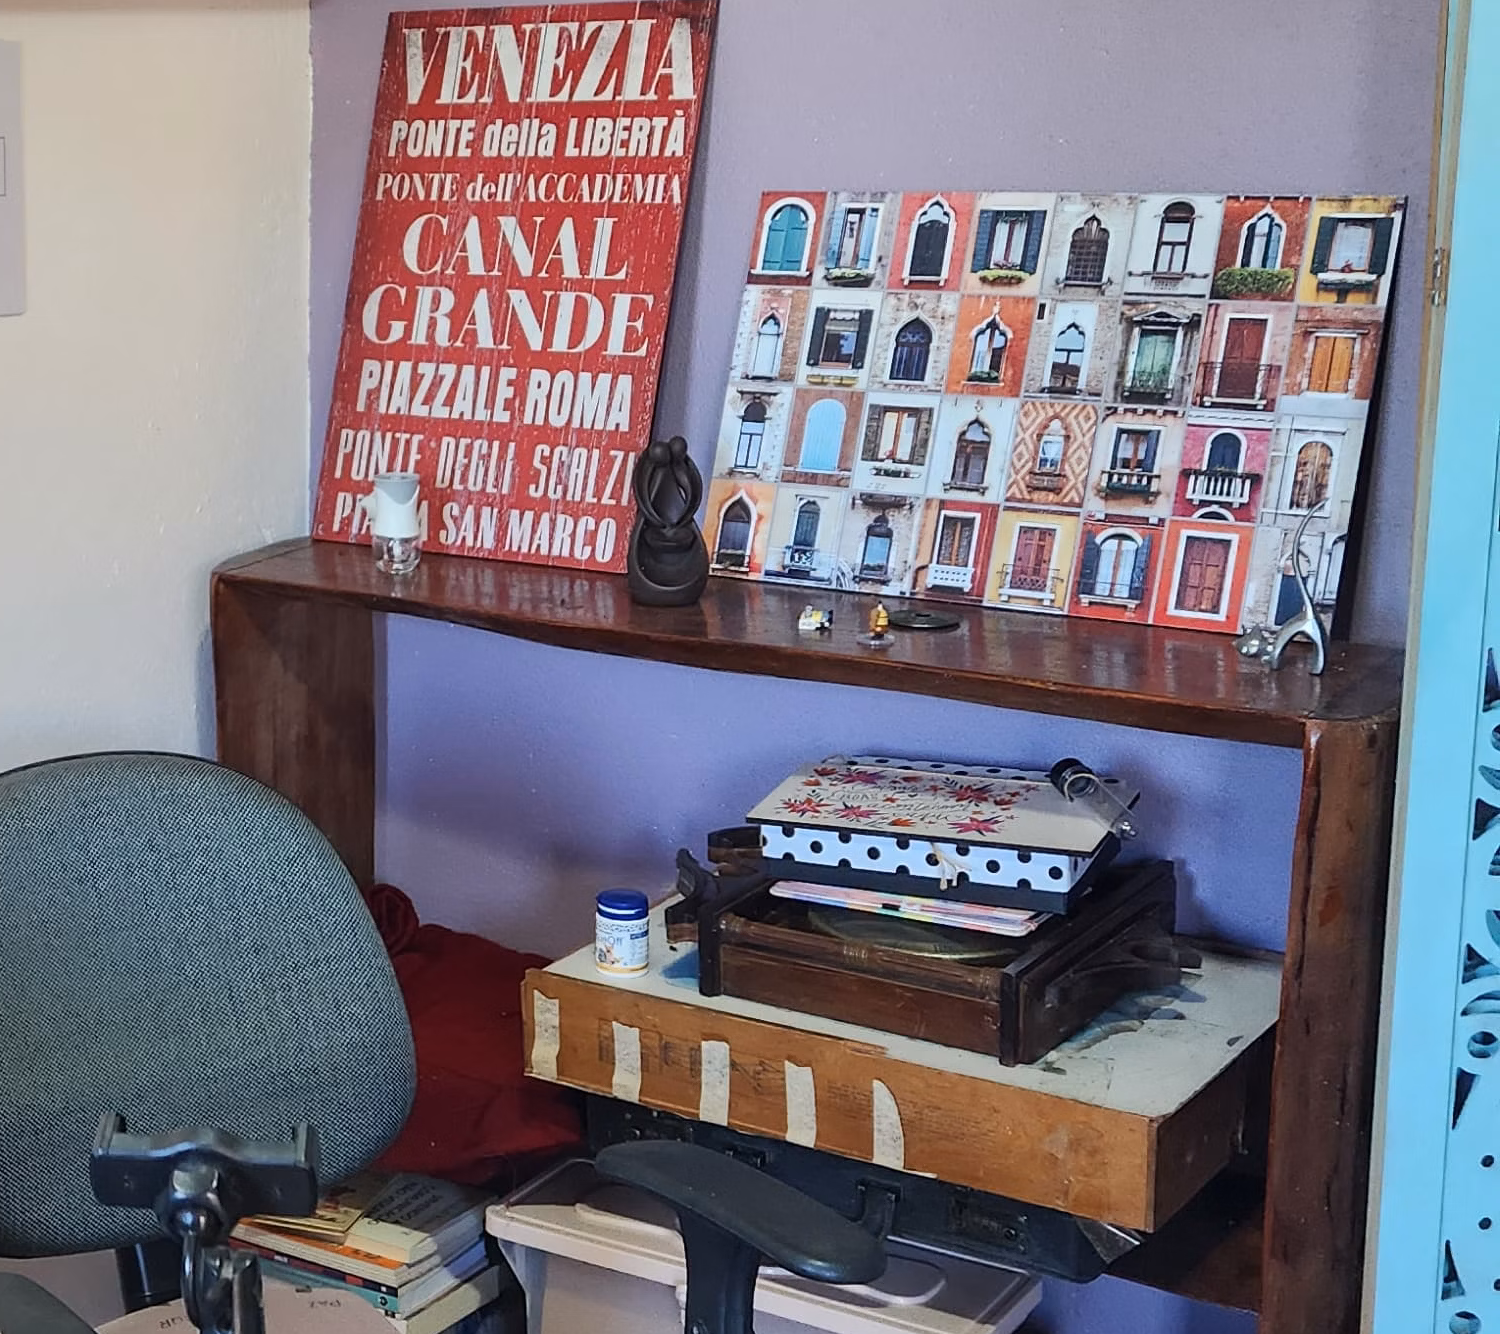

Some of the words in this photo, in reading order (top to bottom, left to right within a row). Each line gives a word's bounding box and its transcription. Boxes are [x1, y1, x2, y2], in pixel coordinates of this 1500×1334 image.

[403, 17, 696, 105] VENEZIA
[388, 119, 476, 158] PONTE
[482, 118, 557, 158] della
[564, 110, 687, 158] LIBERTÀ
[375, 173, 460, 201] PONTE
[466, 171, 682, 204] dell'ACCADEMIA
[403, 213, 628, 280] CANAL
[362, 283, 655, 357] GRANDE
[356, 359, 518, 423] PIAZZALE
[524, 368, 633, 433] ROMA
[334, 428, 424, 482] PONTE
[435, 436, 516, 495] DEGLI
[529, 443, 636, 507] SCALZI
[332, 492, 429, 542] PIA
[439, 501, 498, 550] SAN
[504, 508, 617, 564] MARCO
